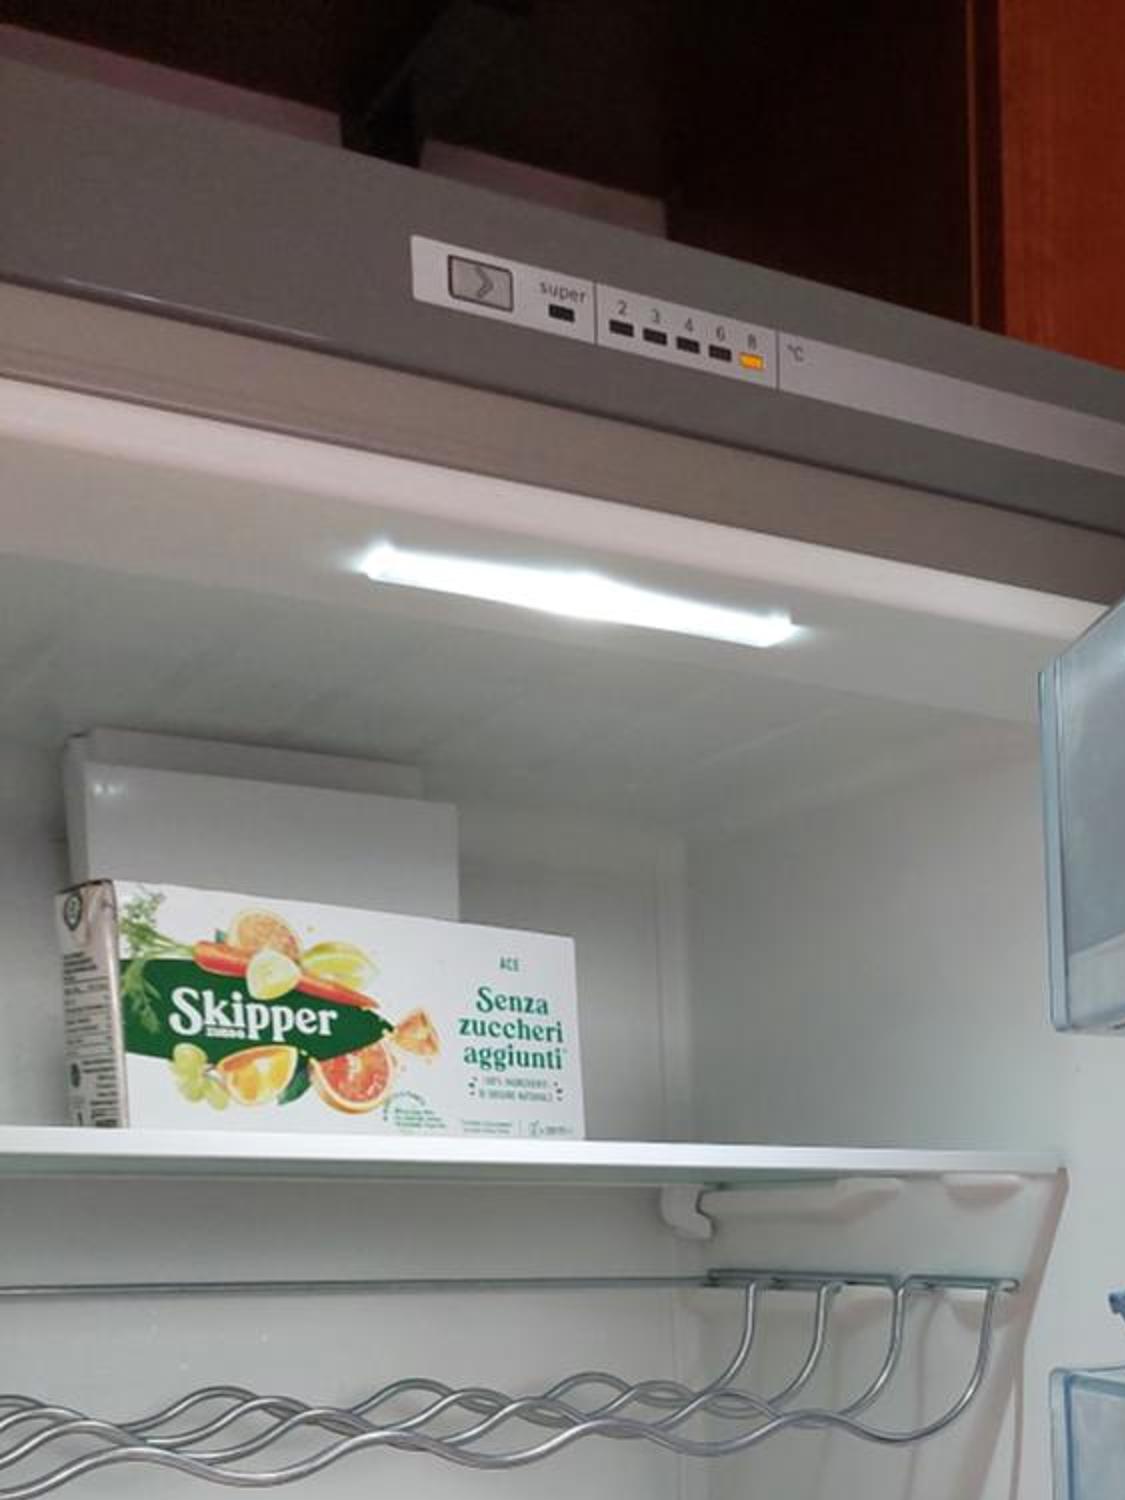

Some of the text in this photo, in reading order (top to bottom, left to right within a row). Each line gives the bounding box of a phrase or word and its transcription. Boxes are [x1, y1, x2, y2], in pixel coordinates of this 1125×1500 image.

[540, 281, 587, 304] super
[618, 300, 628, 316] 2
[652, 308, 661, 324] 3
[684, 318, 694, 333] 4
[715, 326, 726, 342] 6
[168, 986, 339, 1042] Skipper
[476, 985, 549, 1016] Senza
[458, 1018, 564, 1044] zuccheri
[463, 1043, 563, 1073] aggiunti
